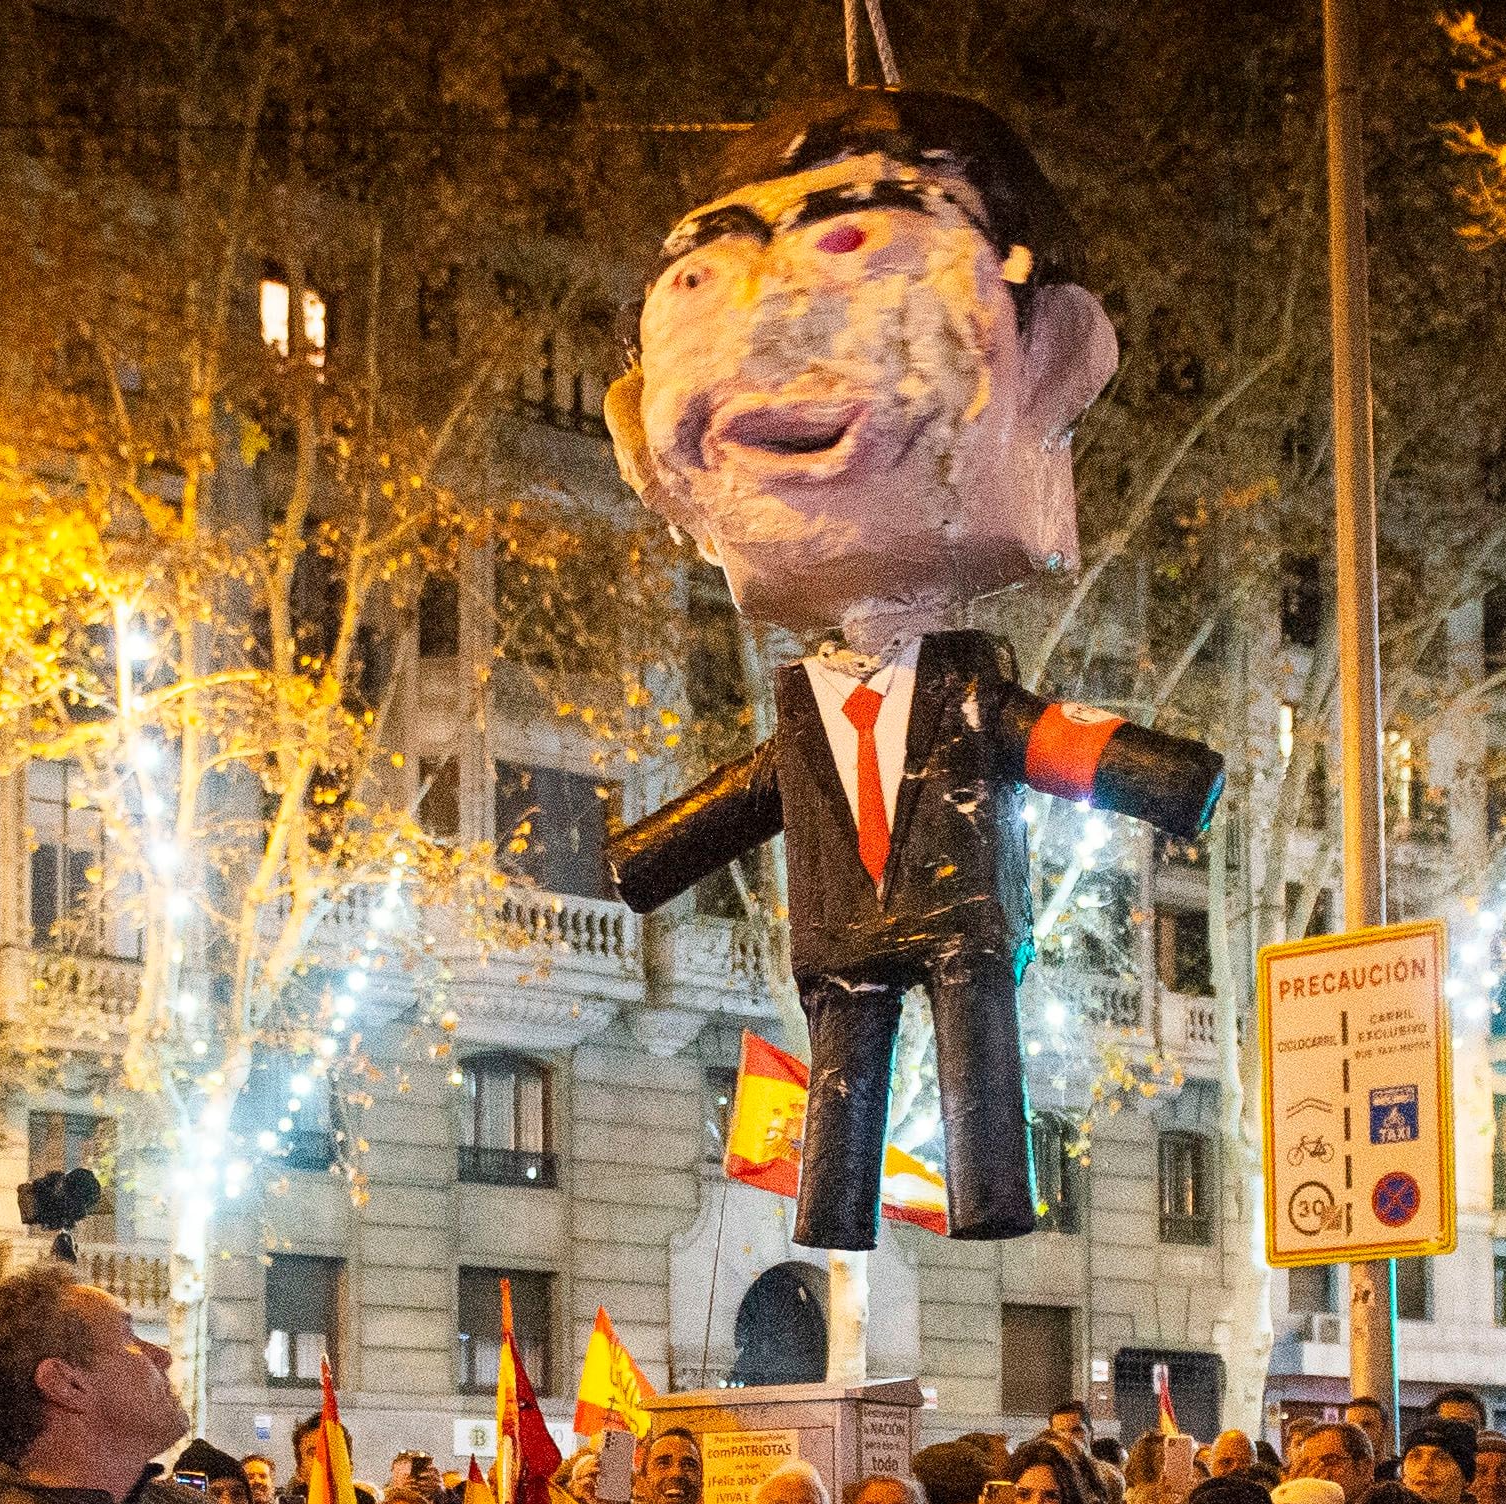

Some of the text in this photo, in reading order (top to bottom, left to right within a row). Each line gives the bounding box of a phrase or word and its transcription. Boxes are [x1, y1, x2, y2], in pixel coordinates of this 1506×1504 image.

[1279, 956, 1426, 1002] PRECAUCIÓN
[1369, 1009, 1414, 1025] CARRIL
[1358, 1023, 1428, 1043] EXCLUSIVO
[1378, 1125, 1412, 1144] TAXI
[1298, 1199, 1325, 1218] 30
